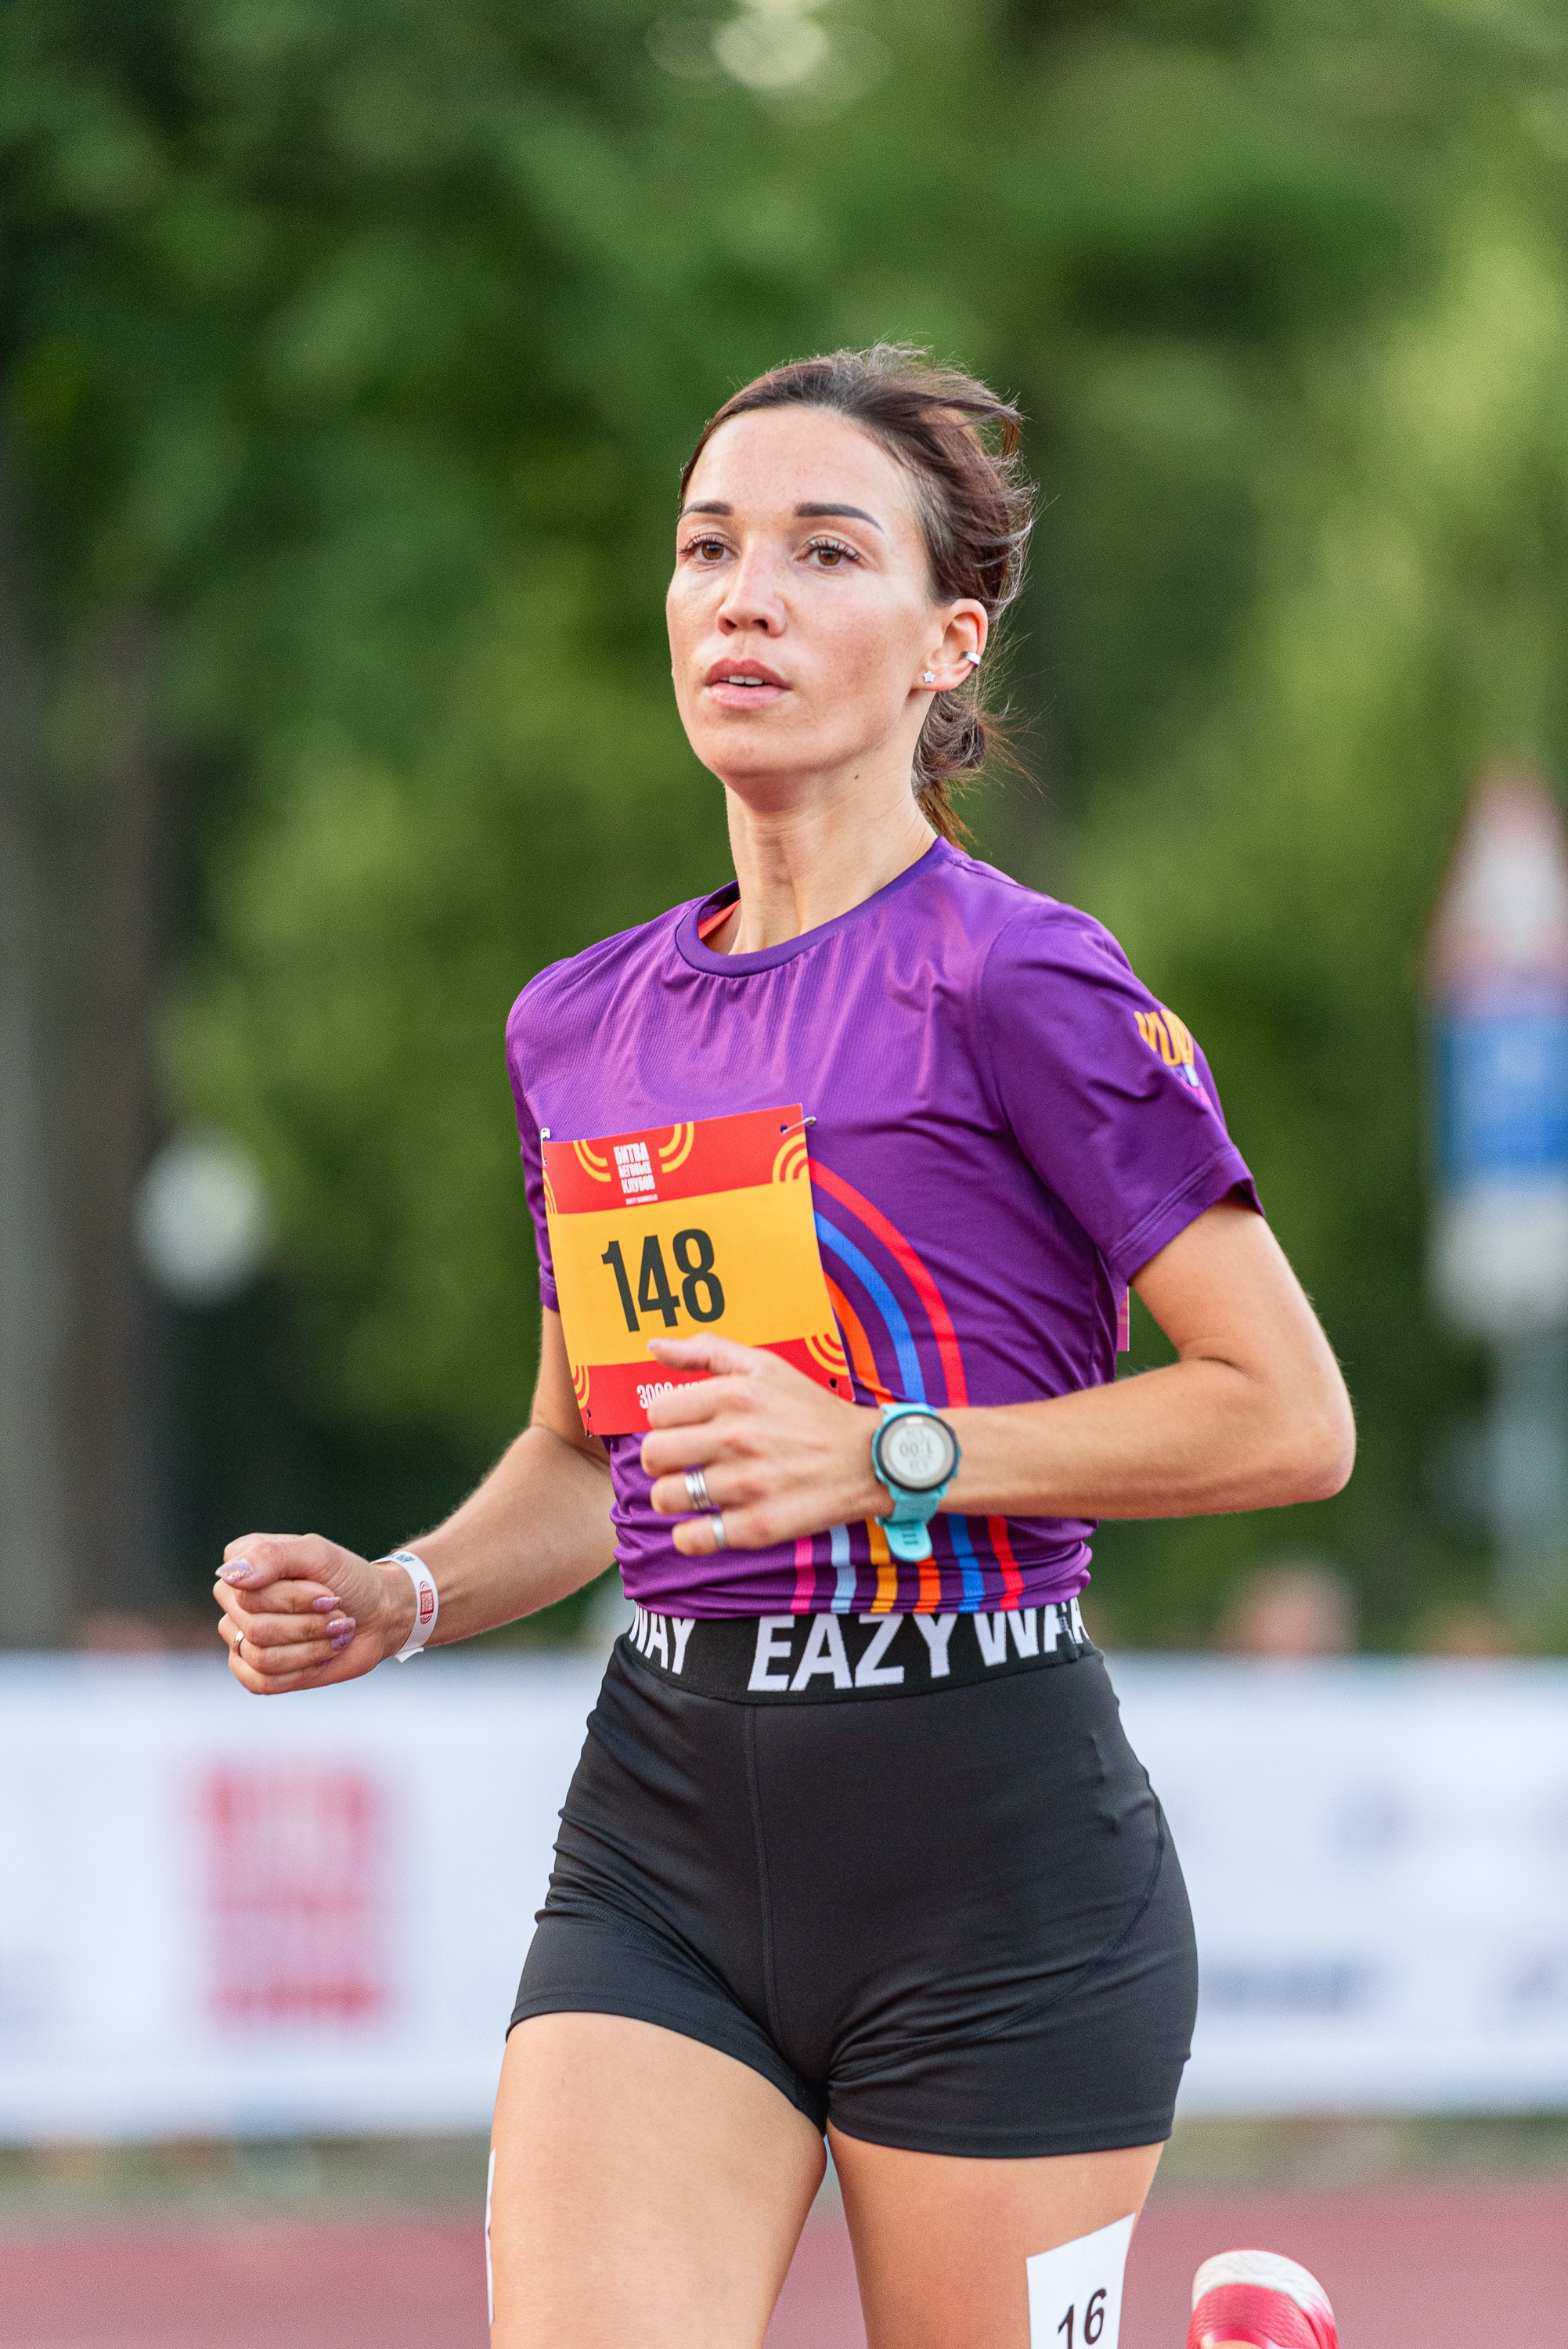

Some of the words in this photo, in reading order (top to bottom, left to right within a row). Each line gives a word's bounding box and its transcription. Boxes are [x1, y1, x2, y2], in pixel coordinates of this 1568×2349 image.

[613, 1142, 650, 1166] БИТВА
[618, 1160, 652, 1179] БЕГОВЫХ
[621, 1174, 655, 1194] КЛУБОВ
[601, 1229, 725, 1333] 148
[1058, 2288, 1107, 2349] 16
